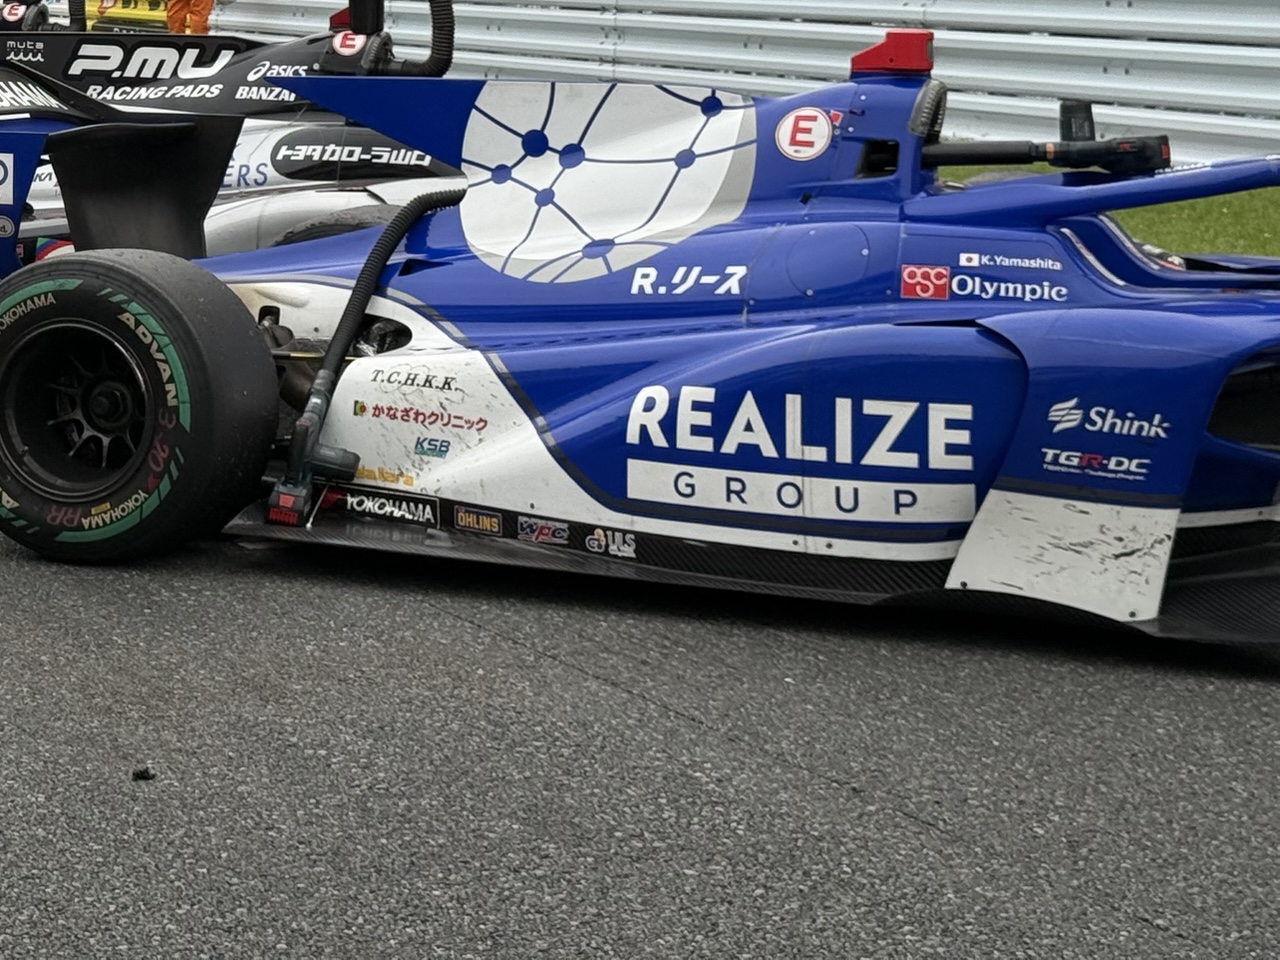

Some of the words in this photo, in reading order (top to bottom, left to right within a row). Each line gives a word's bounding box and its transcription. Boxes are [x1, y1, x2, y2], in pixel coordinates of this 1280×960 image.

[7, 6, 20, 16] E
[339, 33, 357, 49] E
[86, 85, 168, 101] RACING
[168, 83, 225, 99] PADS
[790, 115, 817, 147] E
[980, 254, 1063, 271] K.Yamashita
[630, 265, 748, 295] R.リース
[950, 275, 1069, 302] Olympic
[118, 311, 178, 408] ADVAN
[371, 369, 460, 391] T.C.H.K.K.
[371, 402, 488, 432] かなざわクリニック
[625, 385, 975, 471] REALIZE
[415, 436, 451, 454] KSB
[673, 471, 918, 516] GROUP
[82, 489, 149, 530] YOKOHAMA
[345, 494, 435, 526] YOKOHAMA
[457, 507, 499, 533] ÖHLINS
